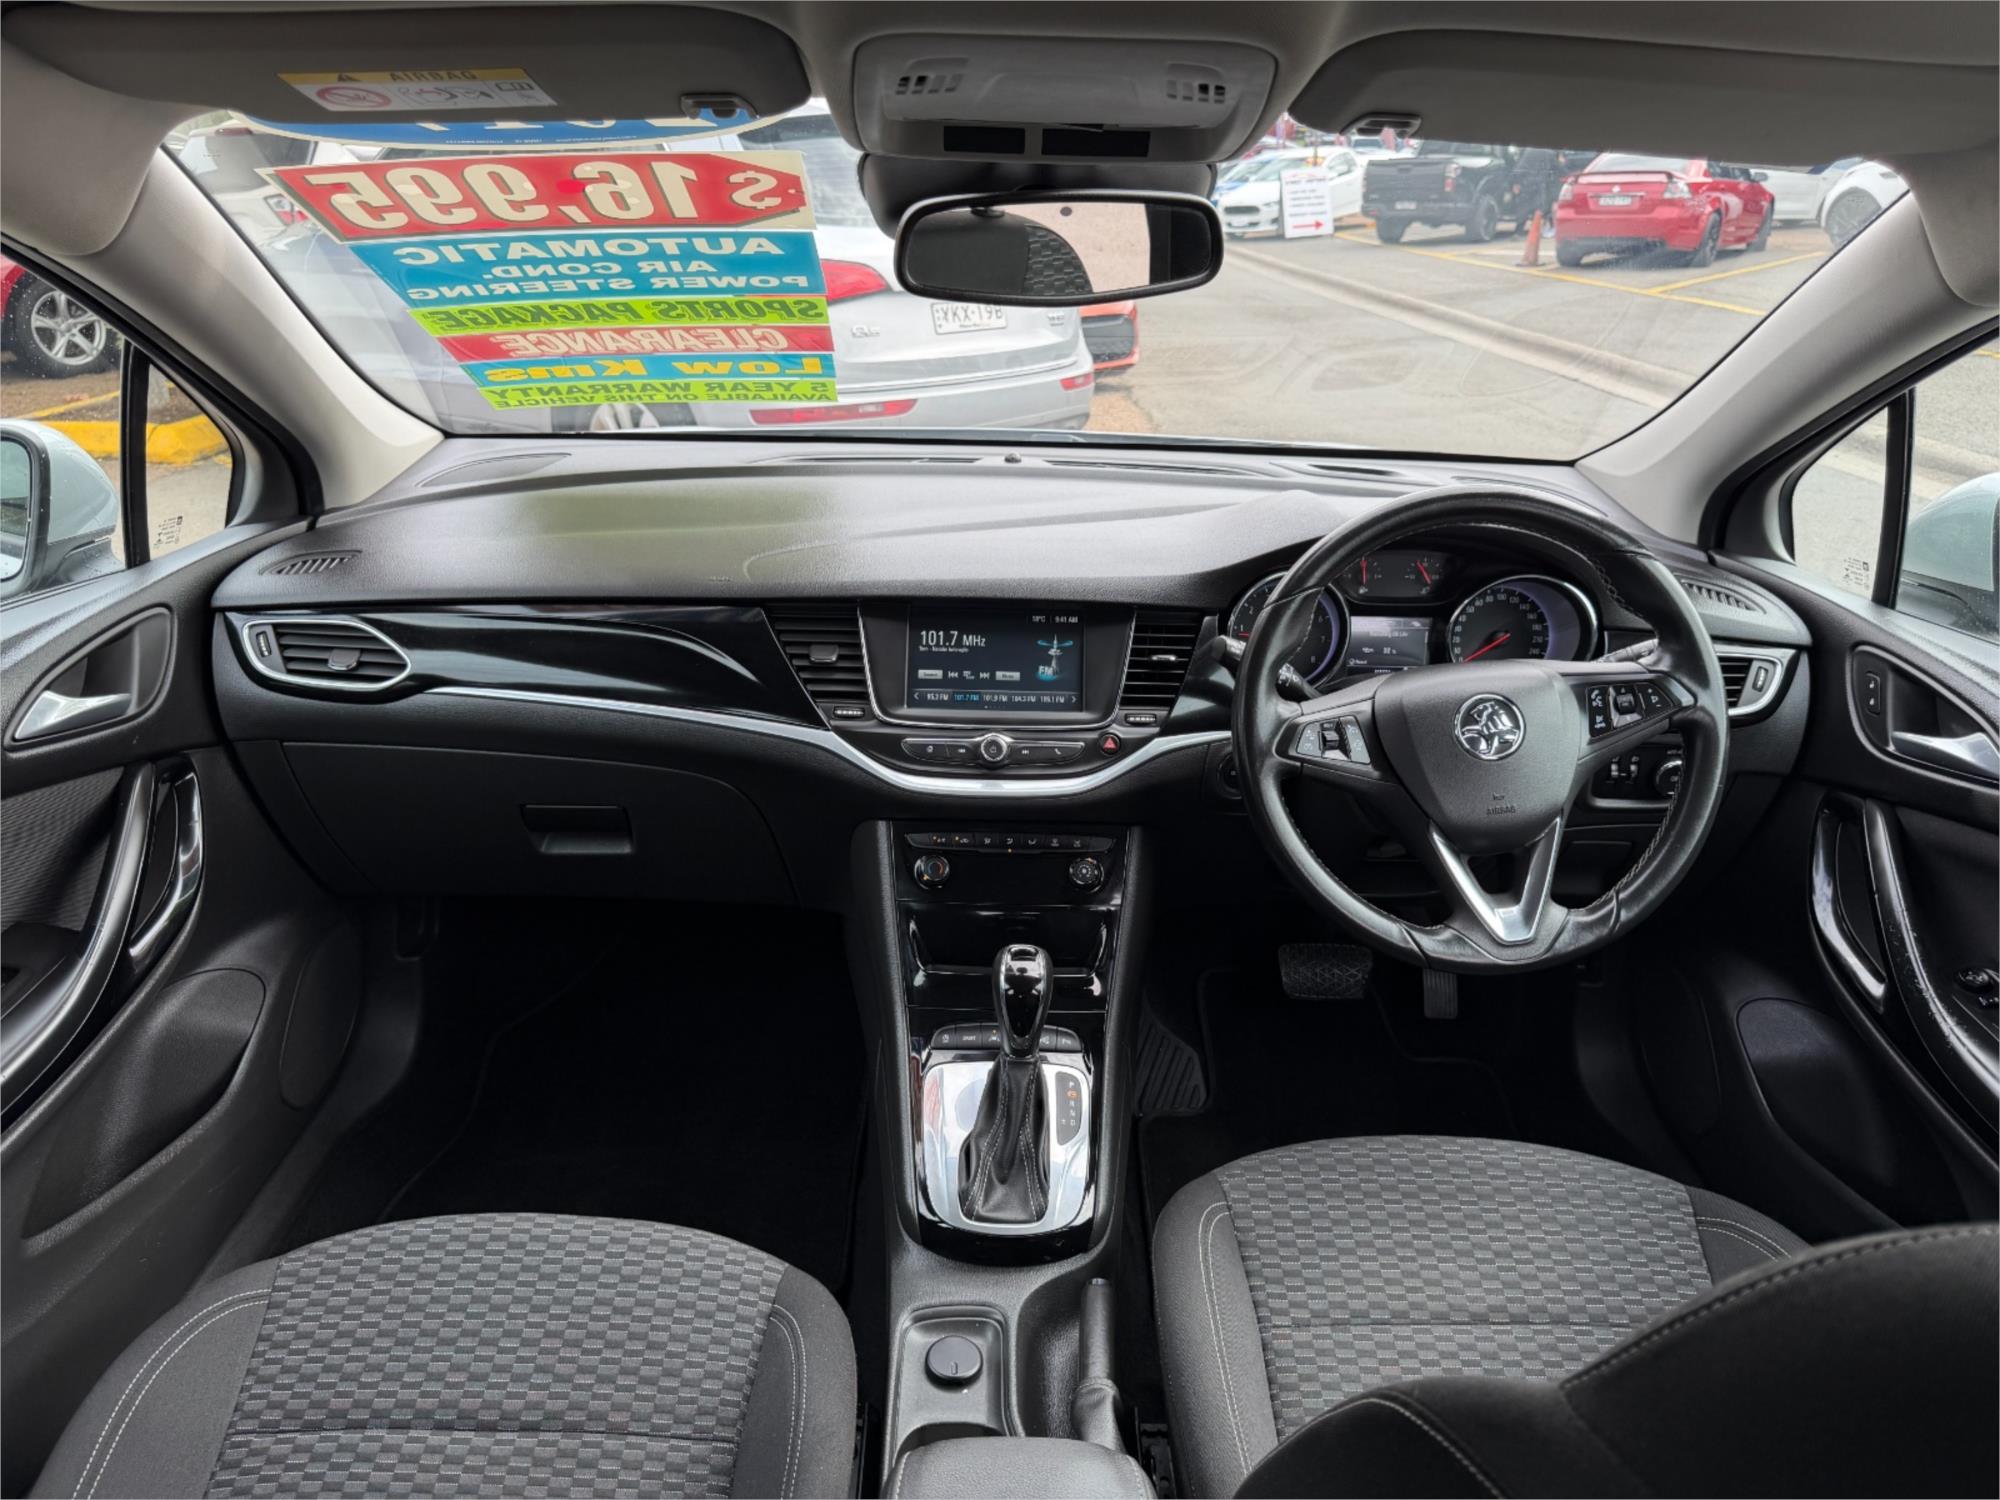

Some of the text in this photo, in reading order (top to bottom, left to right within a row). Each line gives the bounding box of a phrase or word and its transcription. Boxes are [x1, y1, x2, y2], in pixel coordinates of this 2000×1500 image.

[389, 70, 479, 82] AIRBAG
[920, 630, 986, 647] 101.7 MHz
